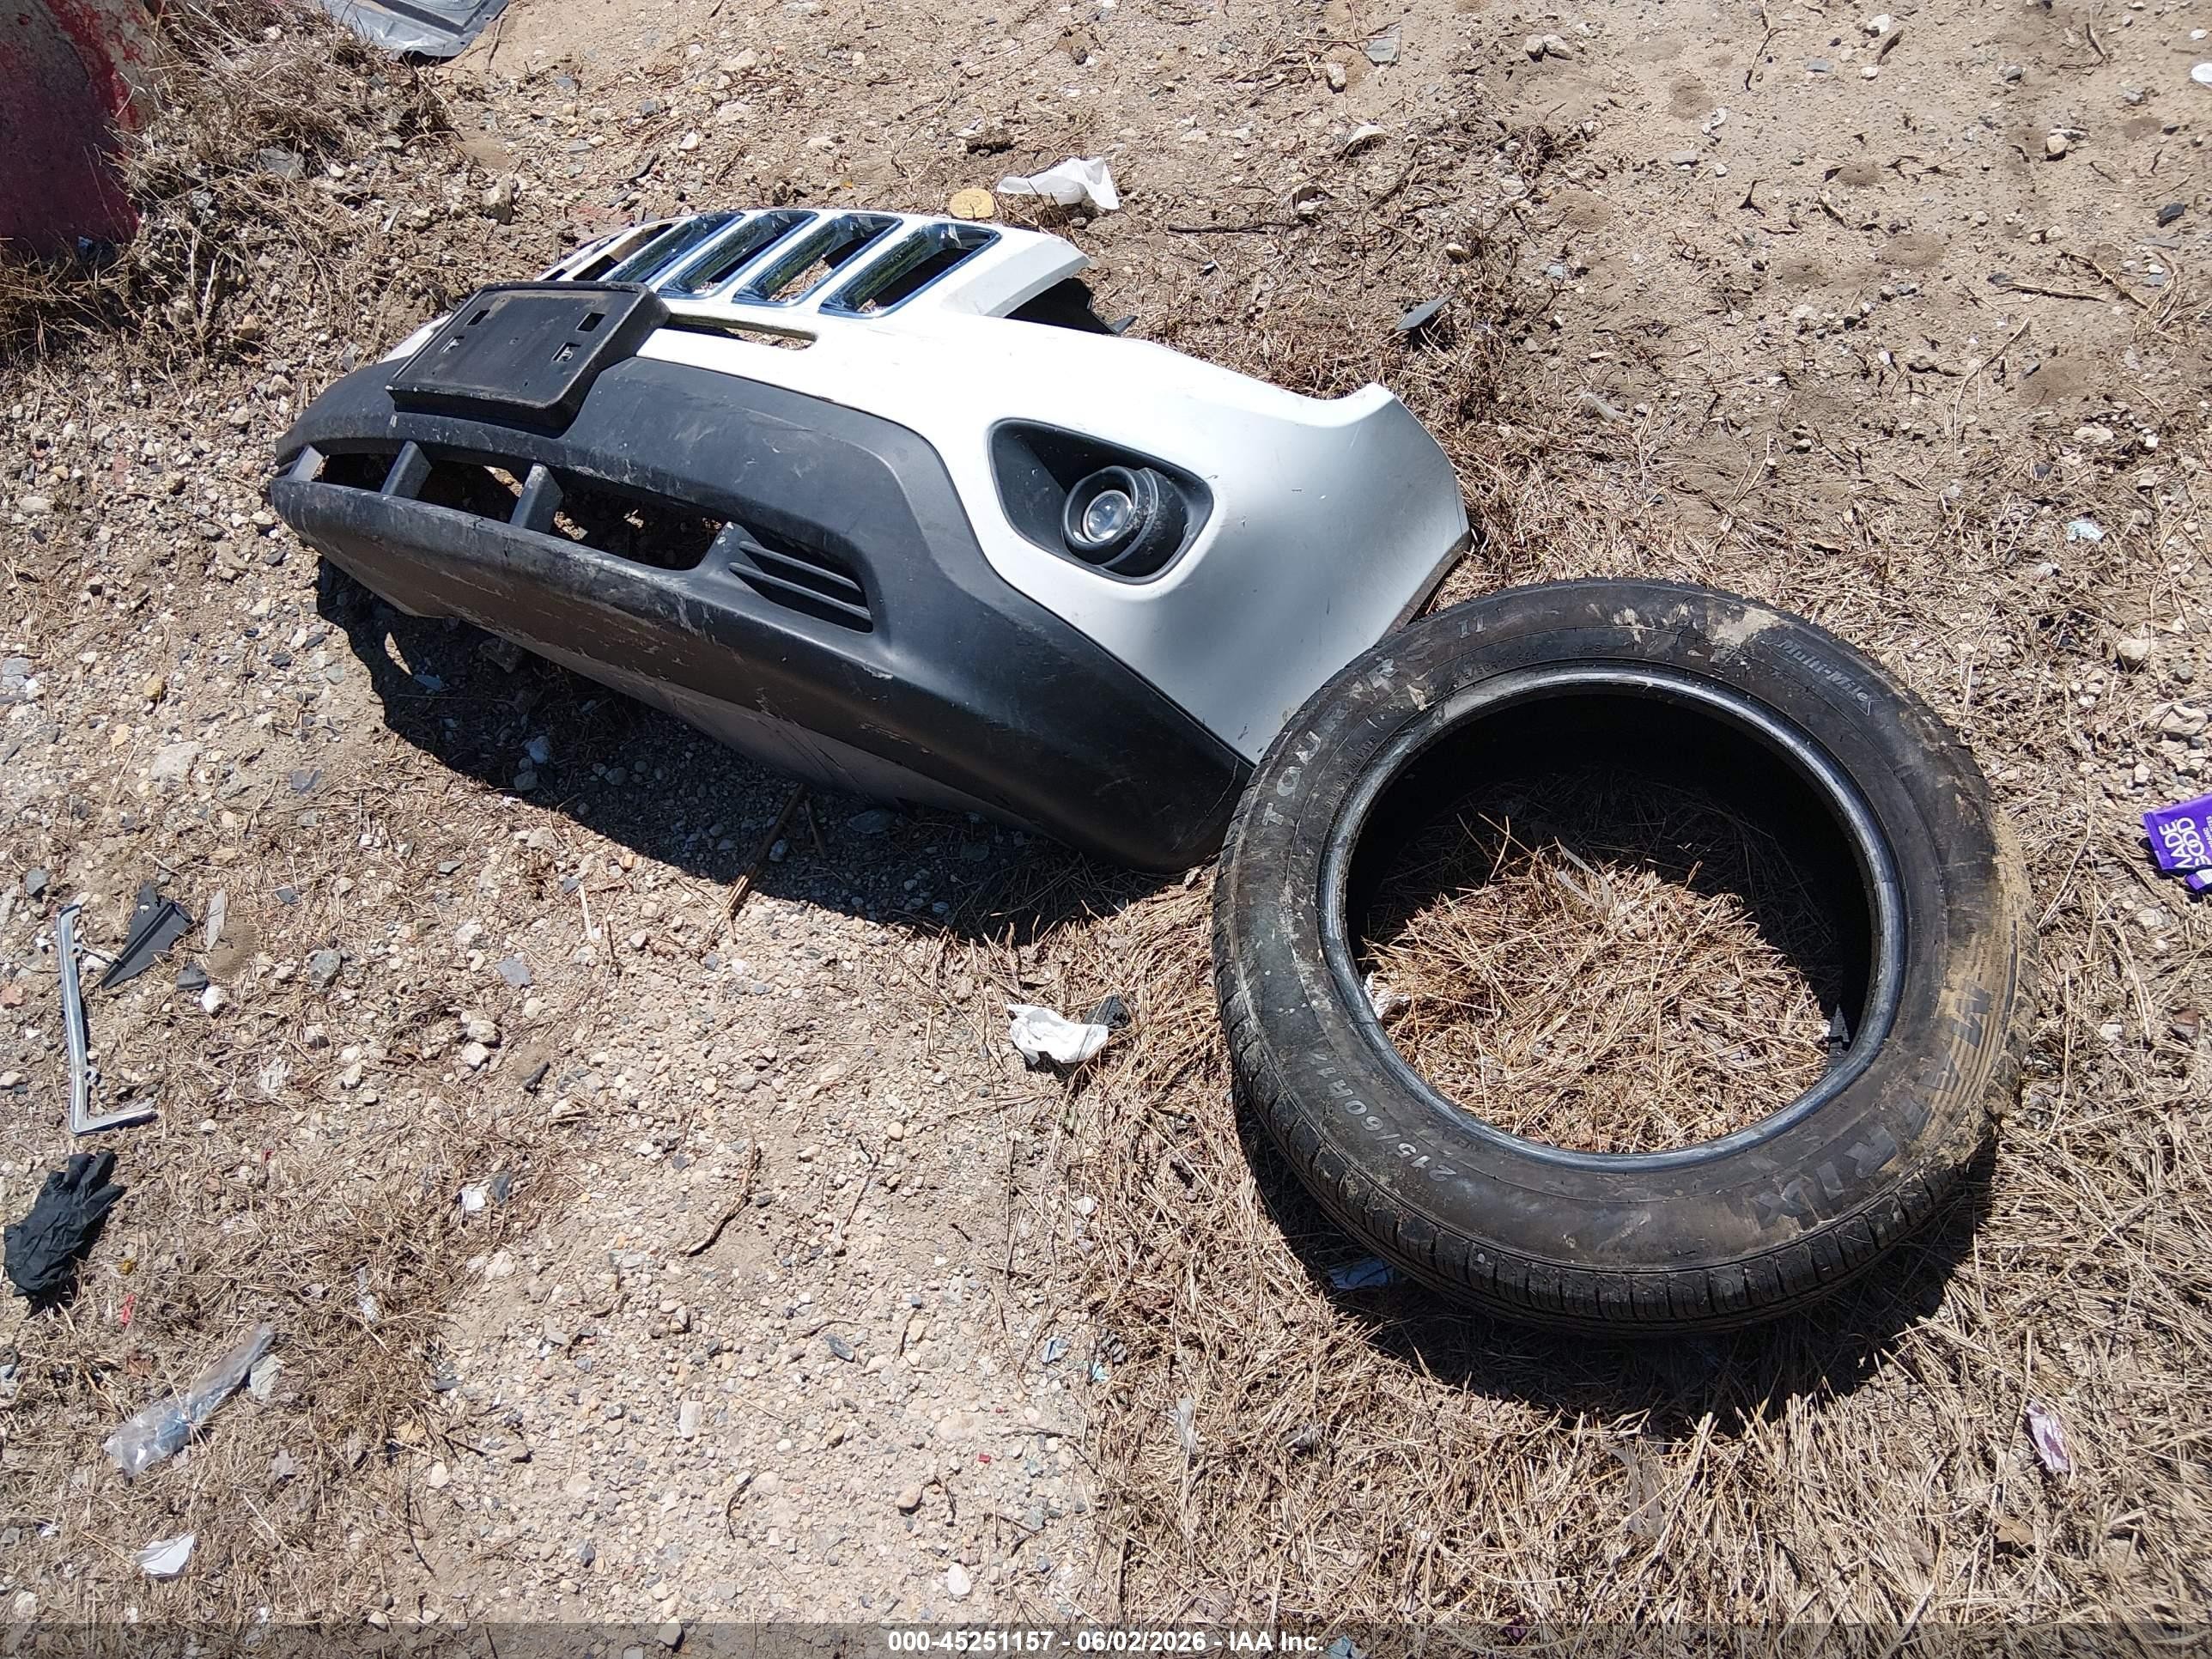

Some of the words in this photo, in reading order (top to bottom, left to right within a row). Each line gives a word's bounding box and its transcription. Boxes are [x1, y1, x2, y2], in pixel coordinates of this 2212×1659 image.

[1774, 638, 1870, 703] Multi-Mile
[2158, 821, 2196, 868] MADE
[1308, 1051, 1458, 1182] 215/60R17
